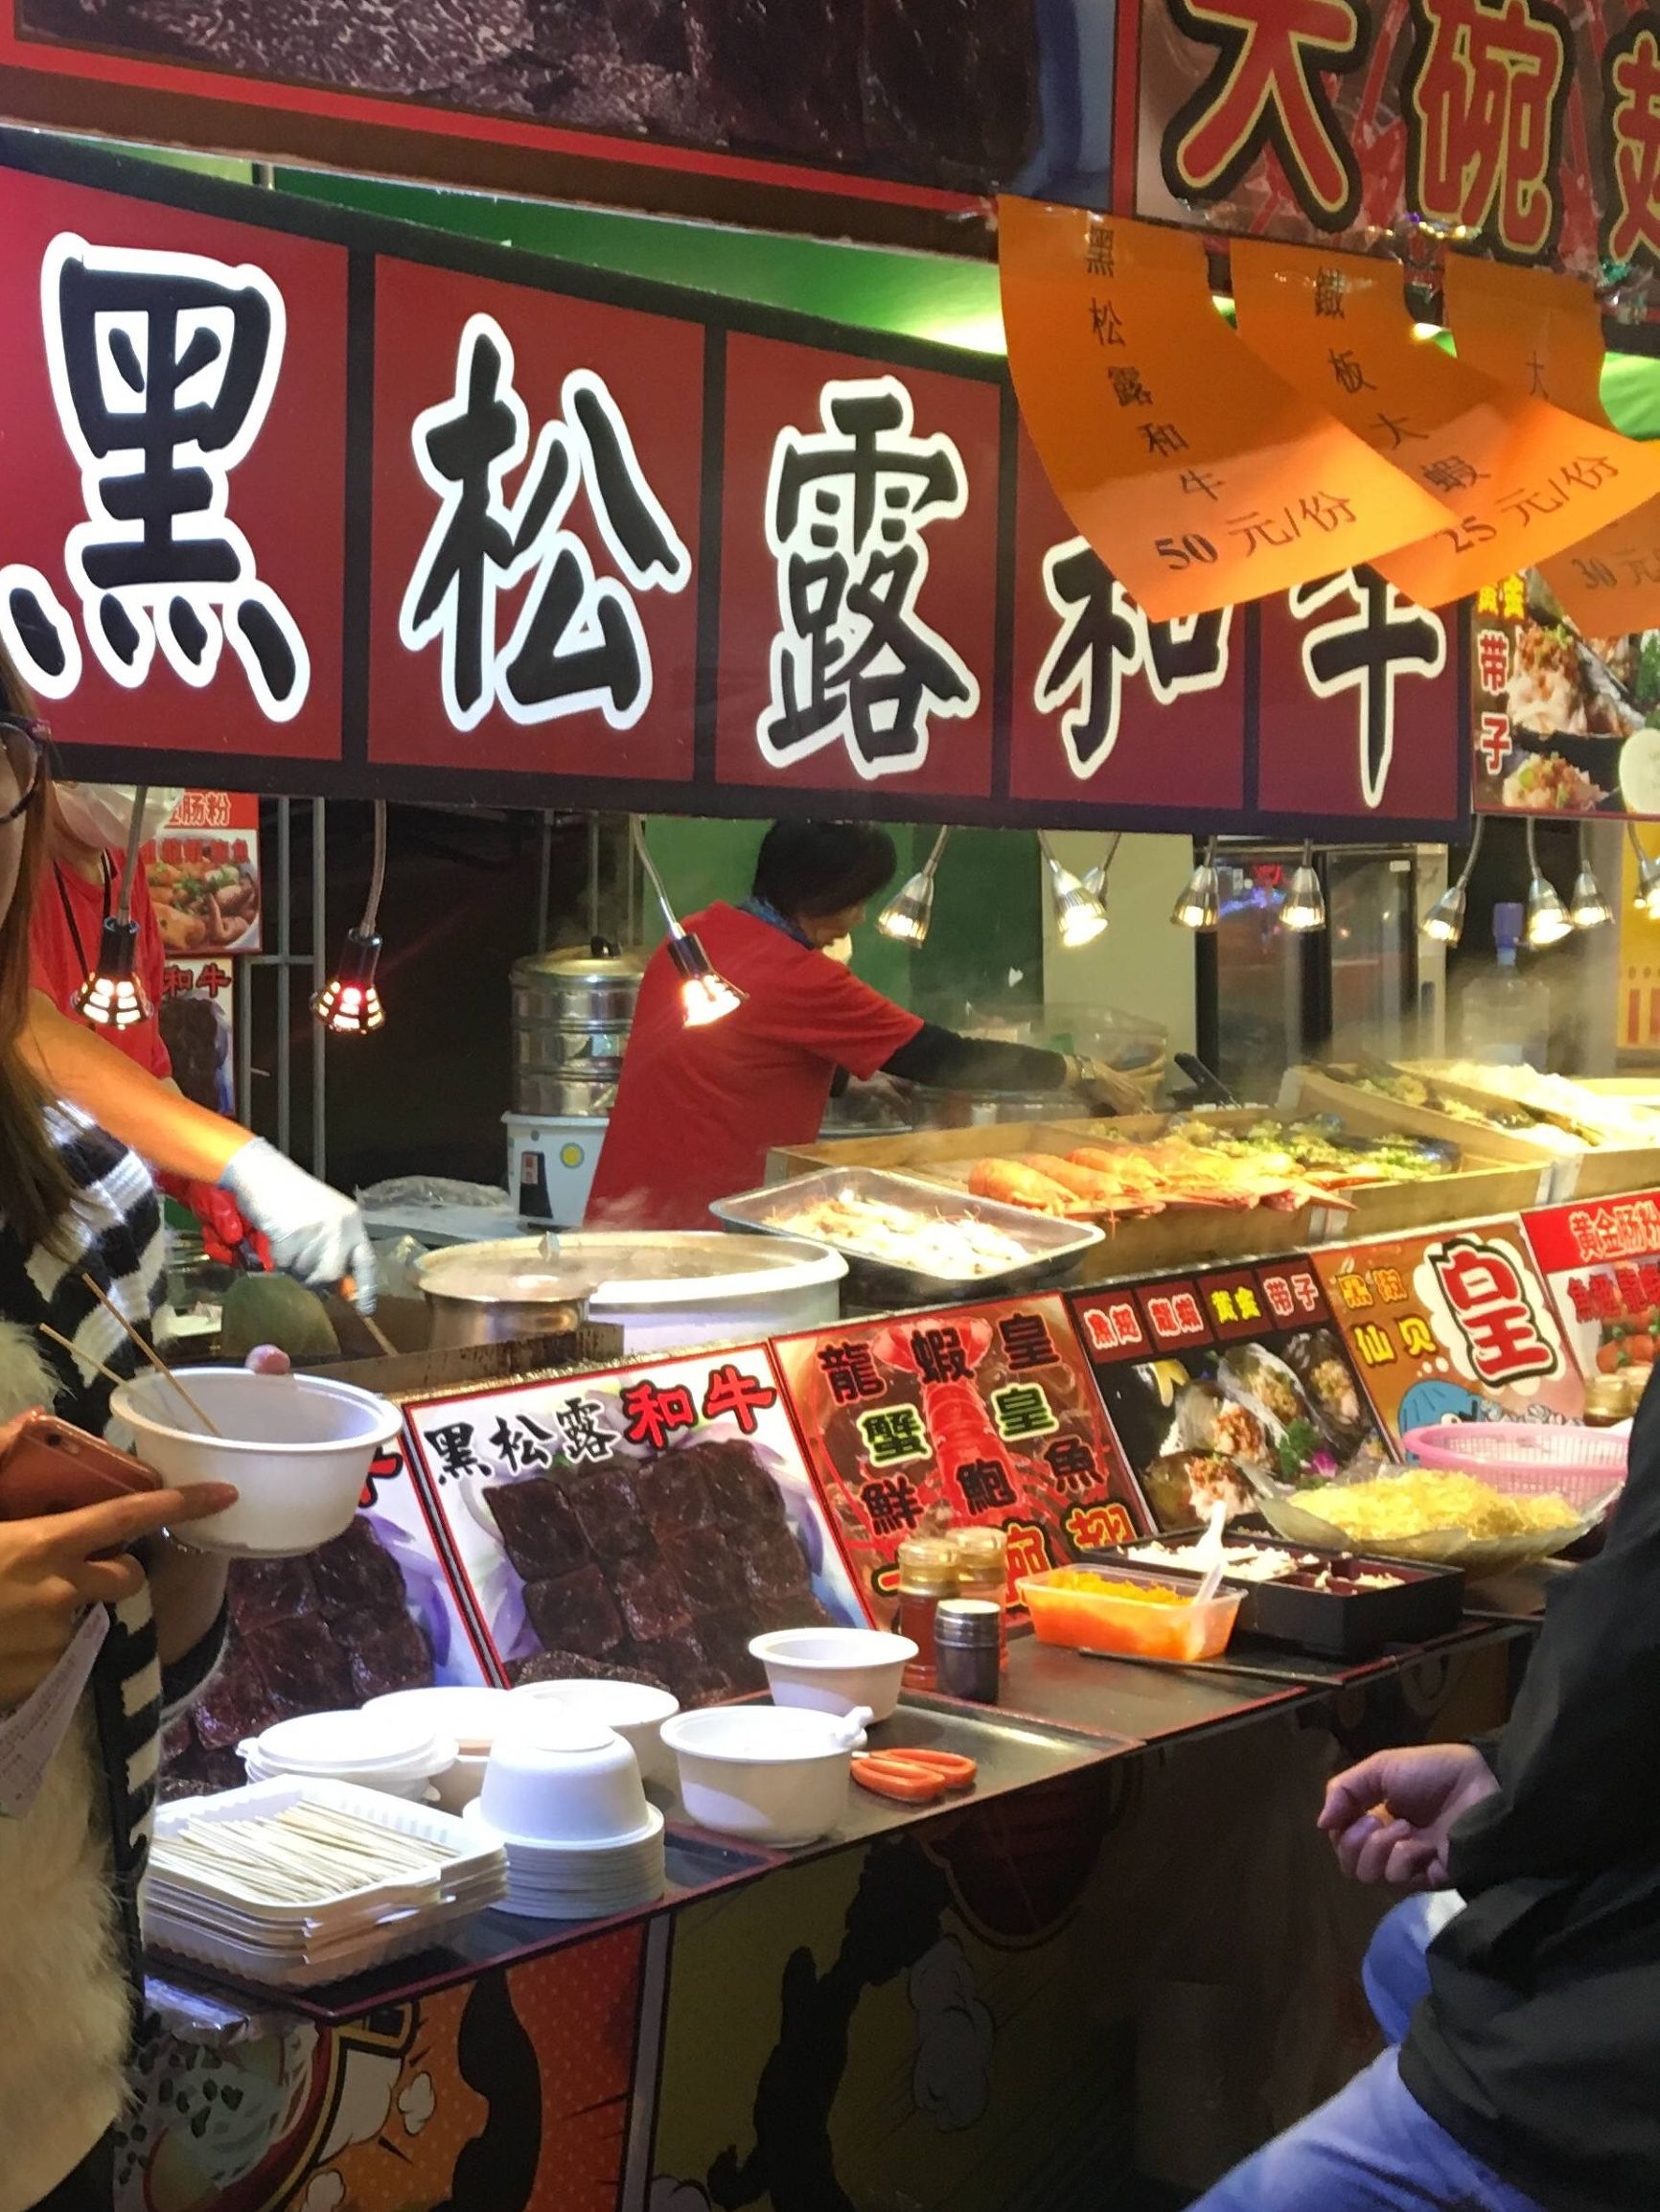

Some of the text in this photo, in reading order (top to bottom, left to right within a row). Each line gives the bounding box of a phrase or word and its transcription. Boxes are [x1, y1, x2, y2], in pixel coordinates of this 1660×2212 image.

[1086, 228, 1223, 501] 黑松露和牛
[0, 231, 1446, 808] 黑松露和牛
[1154, 490, 1354, 571] 50 元/份
[1443, 514, 1499, 556] 25
[170, 791, 231, 826] 肠粉
[818, 1311, 1061, 1405] 龍蝦皇
[1436, 1243, 1556, 1385] 皇
[423, 1363, 778, 1480] 黑松露和牛
